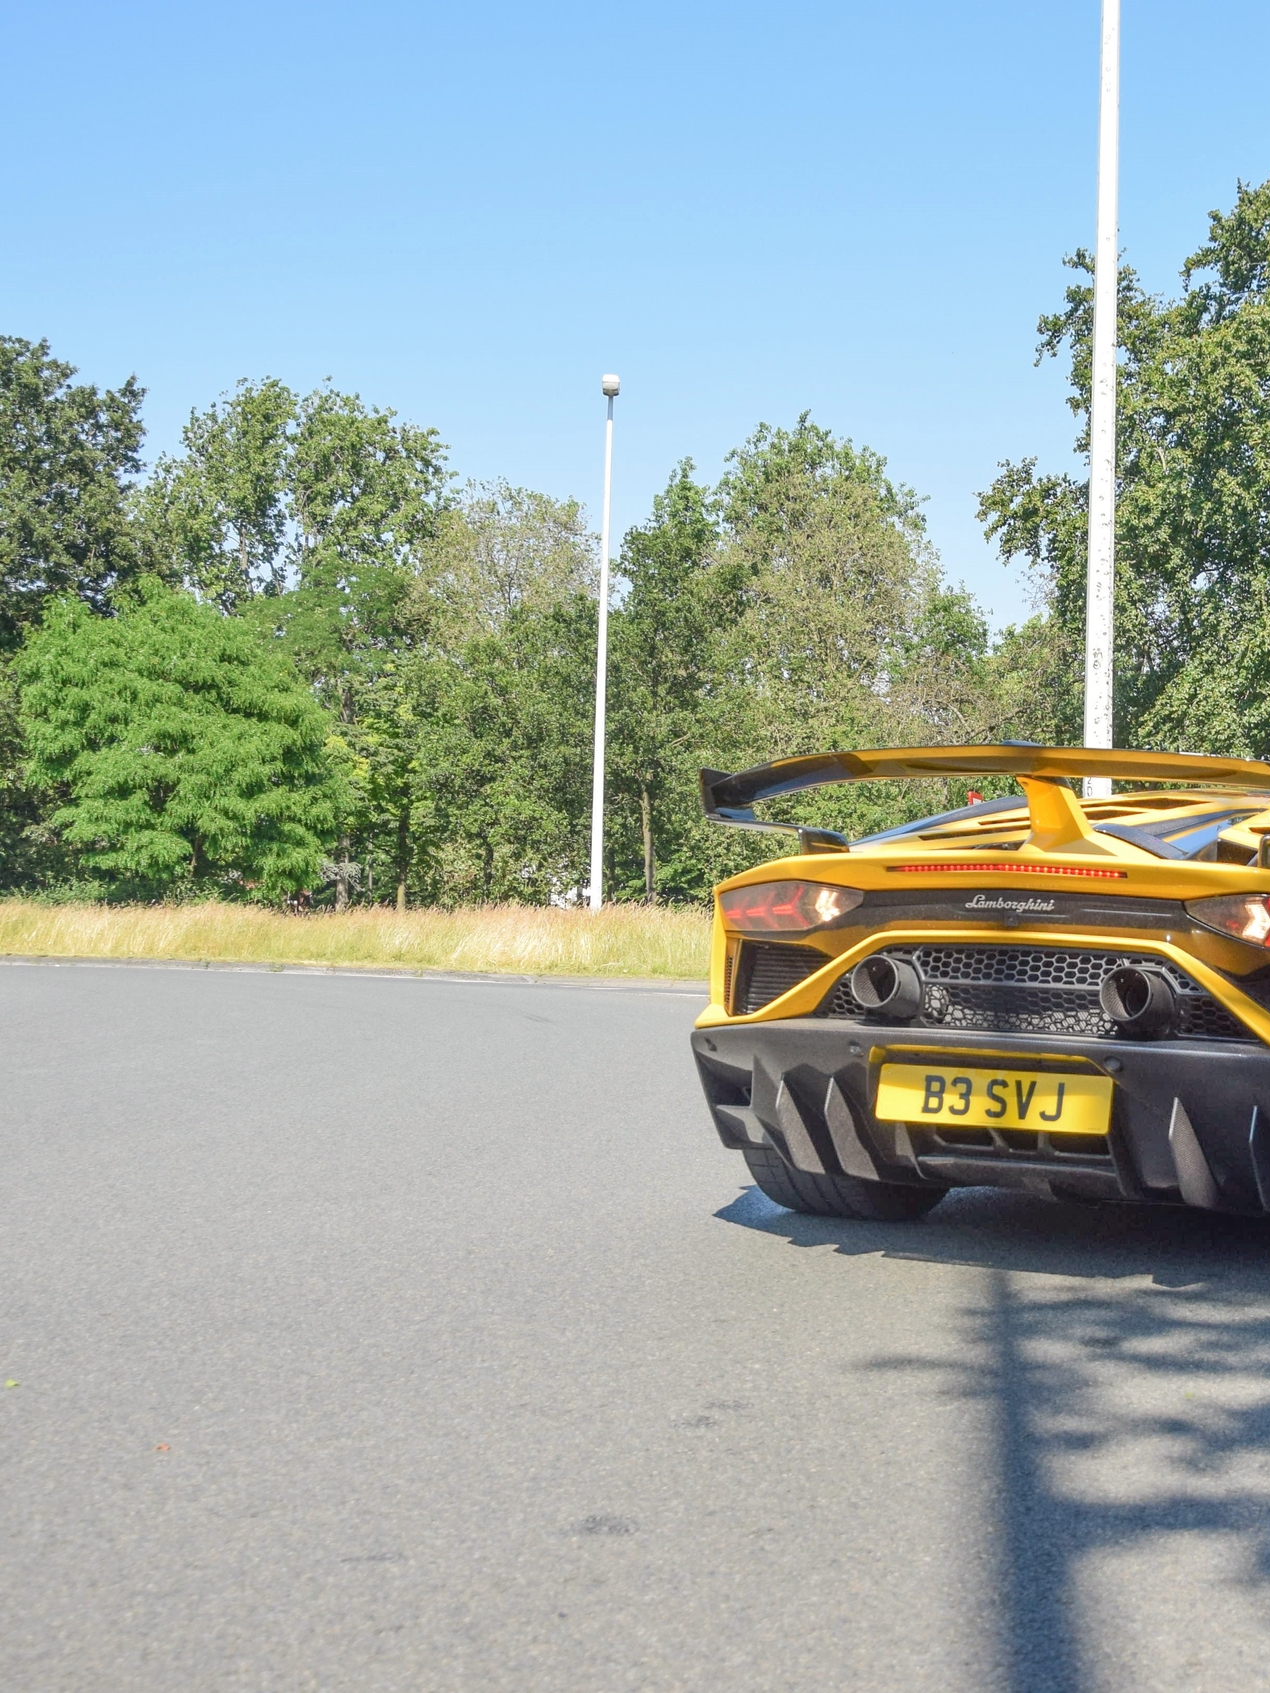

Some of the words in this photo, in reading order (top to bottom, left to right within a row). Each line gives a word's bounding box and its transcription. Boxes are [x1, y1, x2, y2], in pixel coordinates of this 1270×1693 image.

[965, 894, 1055, 913] Lamborghini
[921, 1074, 973, 1115] B3
[984, 1079, 1065, 1122] SVJ
